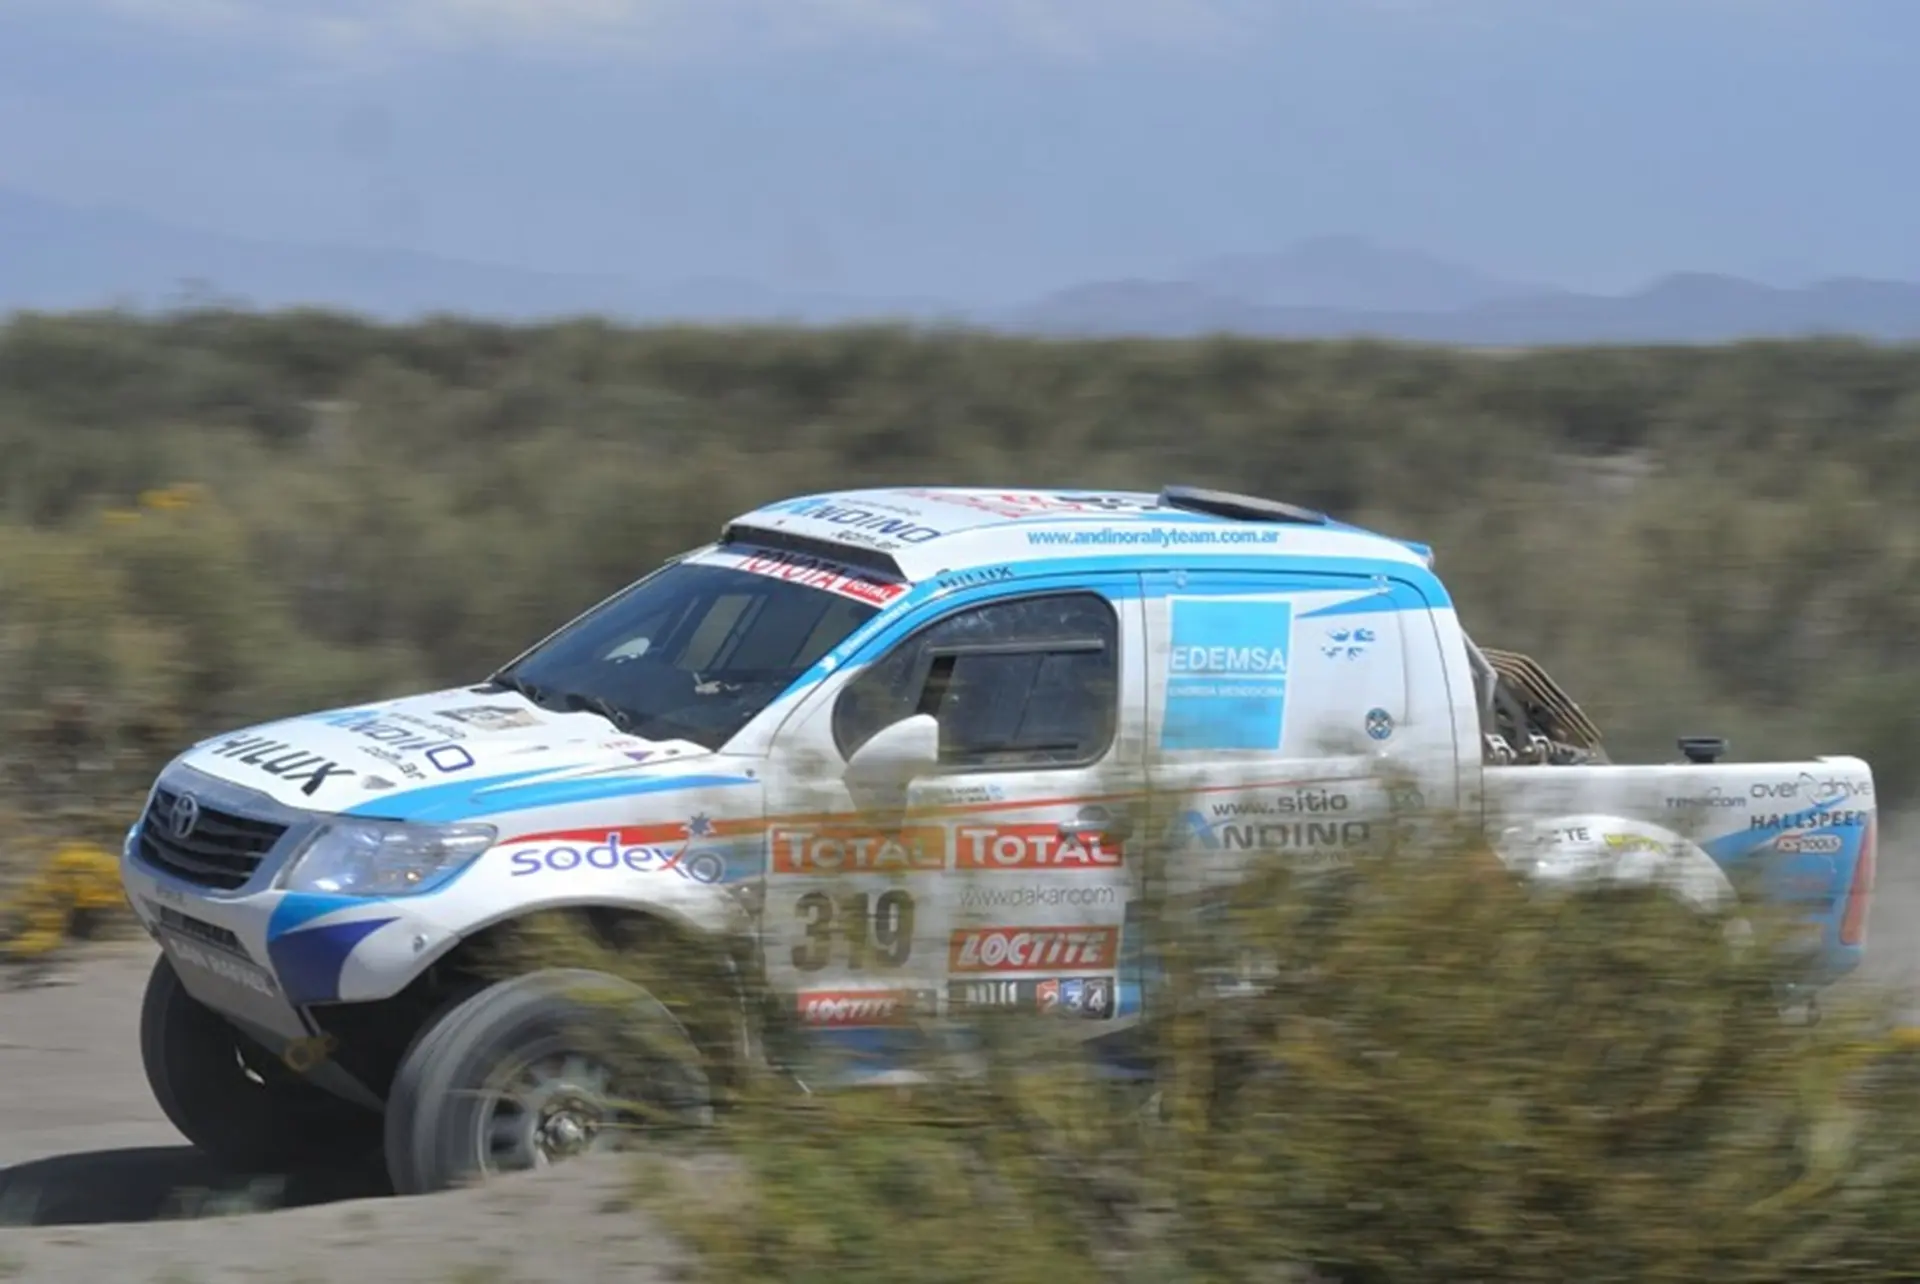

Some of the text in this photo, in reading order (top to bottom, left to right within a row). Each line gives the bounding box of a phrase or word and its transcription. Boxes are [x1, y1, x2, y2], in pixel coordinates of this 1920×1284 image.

[1027, 528, 1280, 548] www.andinorallyteam.com.ar
[937, 566, 1015, 588] HILUX
[1171, 646, 1286, 671] EDEMSA
[211, 737, 357, 797] HILUX
[777, 831, 943, 868] TOTAL
[961, 828, 1119, 865] TOTAL
[791, 890, 915, 972] 319
[957, 933, 1107, 966] LOCTITE
